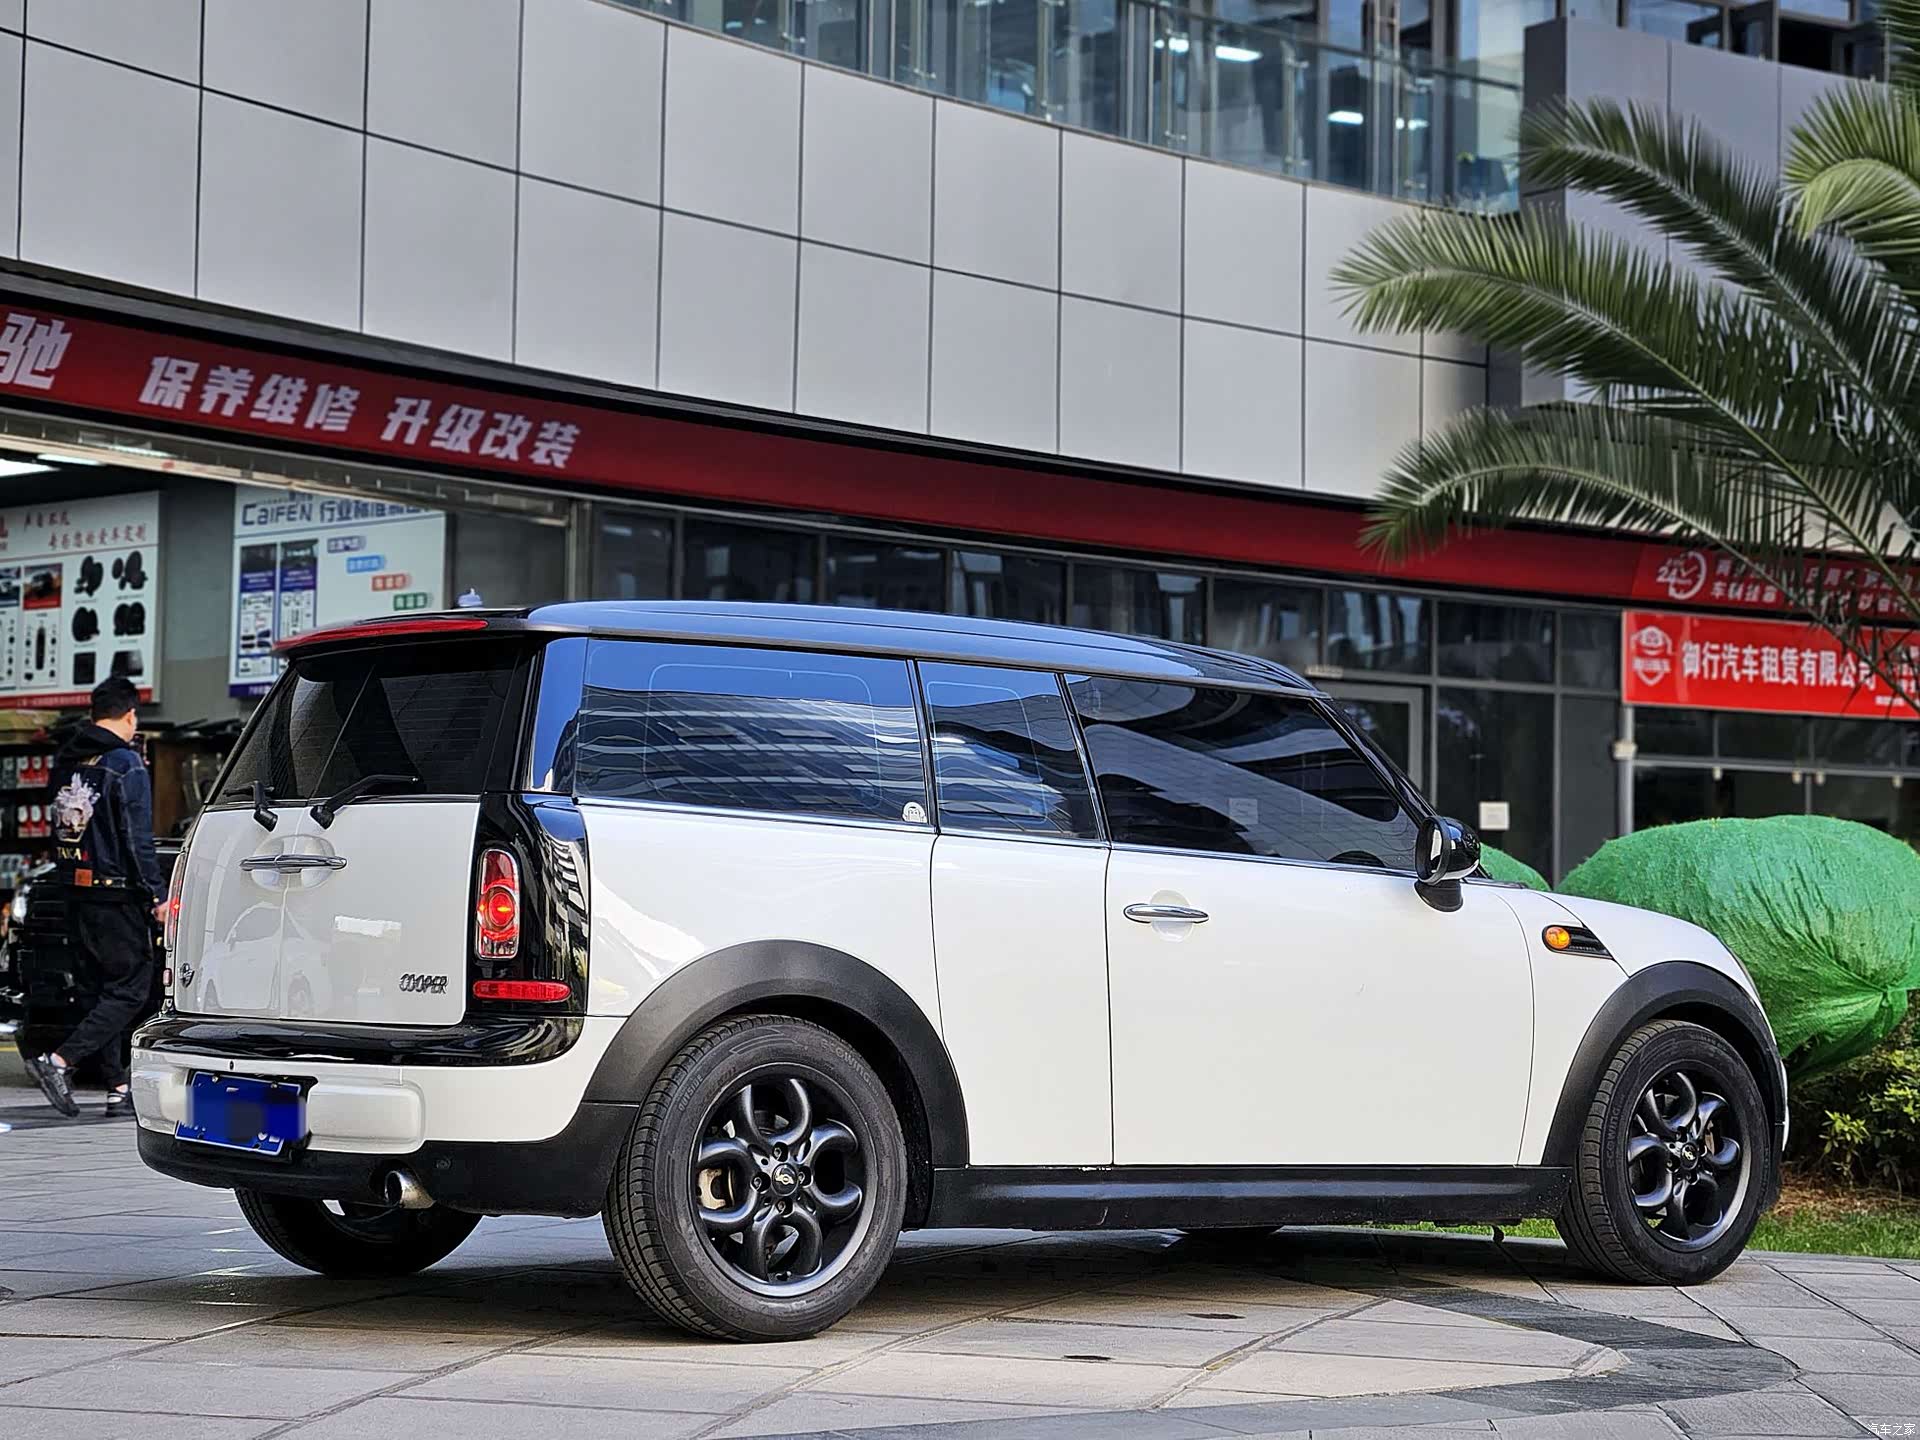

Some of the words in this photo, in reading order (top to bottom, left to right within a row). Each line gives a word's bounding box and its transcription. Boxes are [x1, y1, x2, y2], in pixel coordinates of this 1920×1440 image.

[138, 355, 360, 432] 保养维修
[380, 397, 580, 468] 升级改装
[399, 972, 448, 995] COOPER
[678, 1074, 703, 1112] OUTSIDE
